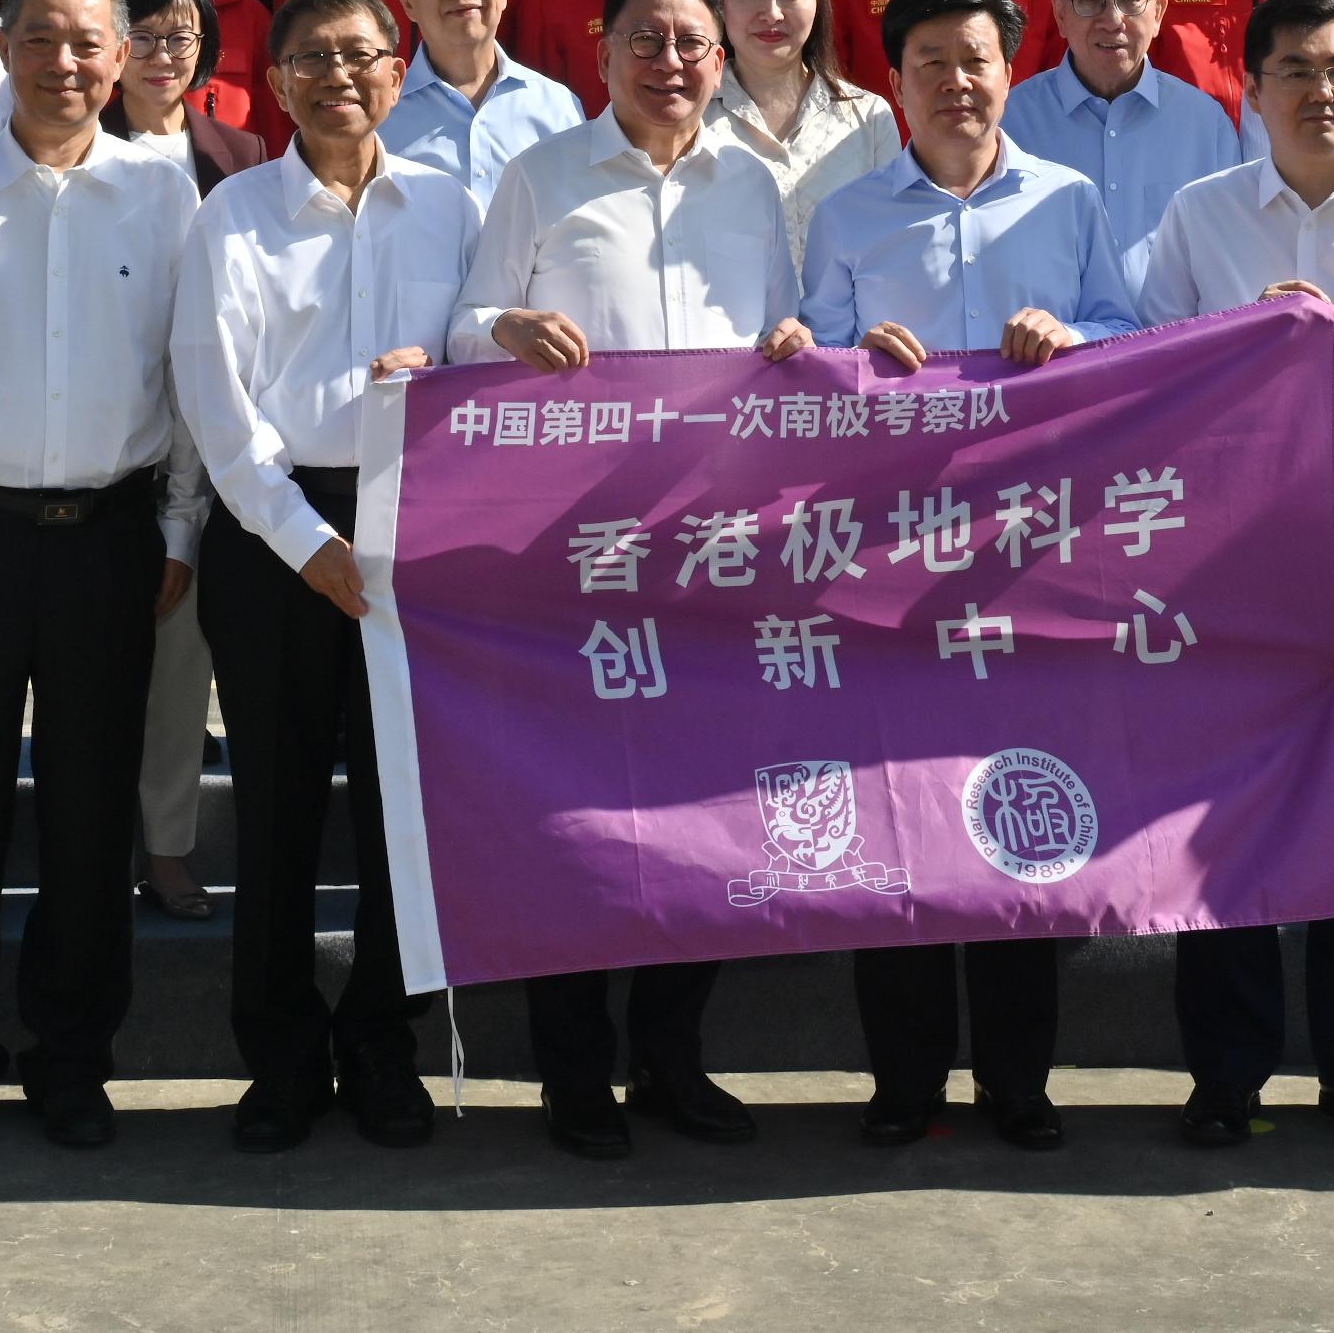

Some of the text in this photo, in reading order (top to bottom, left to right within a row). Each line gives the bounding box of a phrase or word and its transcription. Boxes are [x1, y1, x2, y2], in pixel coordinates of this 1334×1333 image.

[448, 384, 1011, 448] 中国第四十一次南极考察队
[566, 465, 1186, 595] 香港极地科学
[578, 588, 1199, 701] 创新中心
[965, 751, 1095, 858] Polar Research Institute of China
[1014, 860, 1066, 878] 1989
